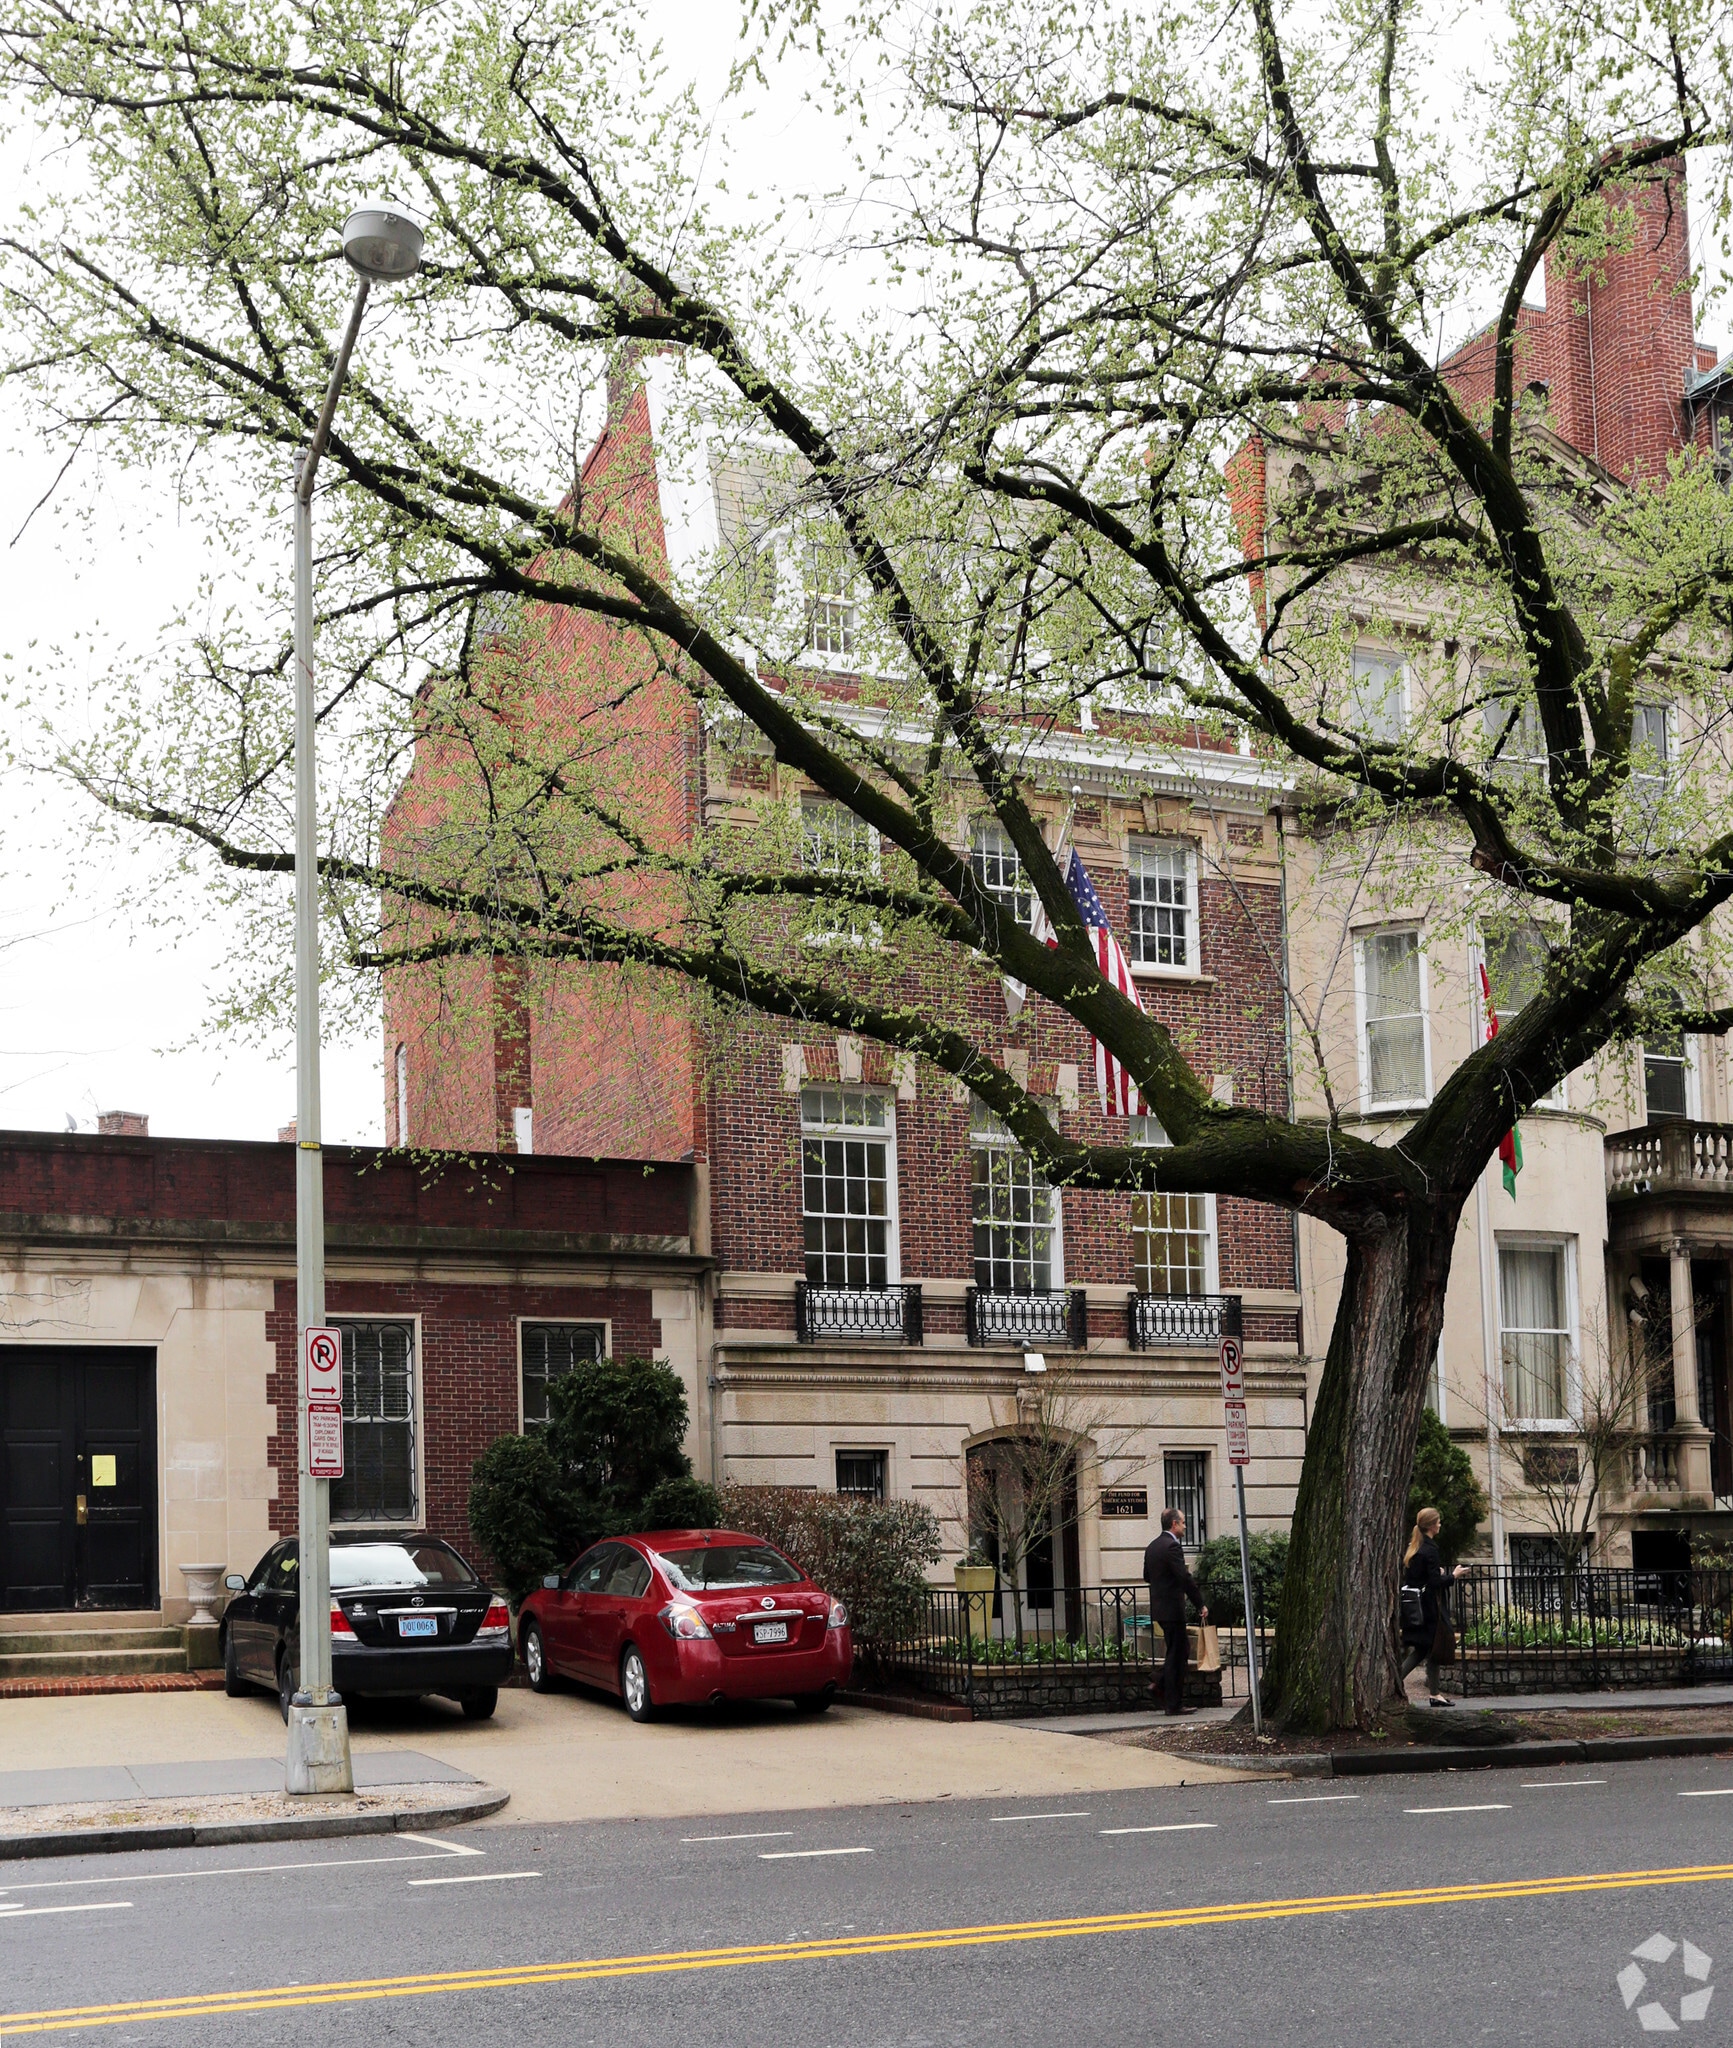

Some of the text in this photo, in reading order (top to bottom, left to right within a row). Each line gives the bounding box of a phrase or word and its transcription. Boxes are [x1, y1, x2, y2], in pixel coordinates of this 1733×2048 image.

[317, 1344, 330, 1363] P
[1226, 1346, 1237, 1368] P
[1231, 1411, 1240, 1419] NO
[1228, 1421, 1245, 1429] PARKING
[1116, 1505, 1133, 1514] 1621
[417, 1620, 435, 1631] 0068
